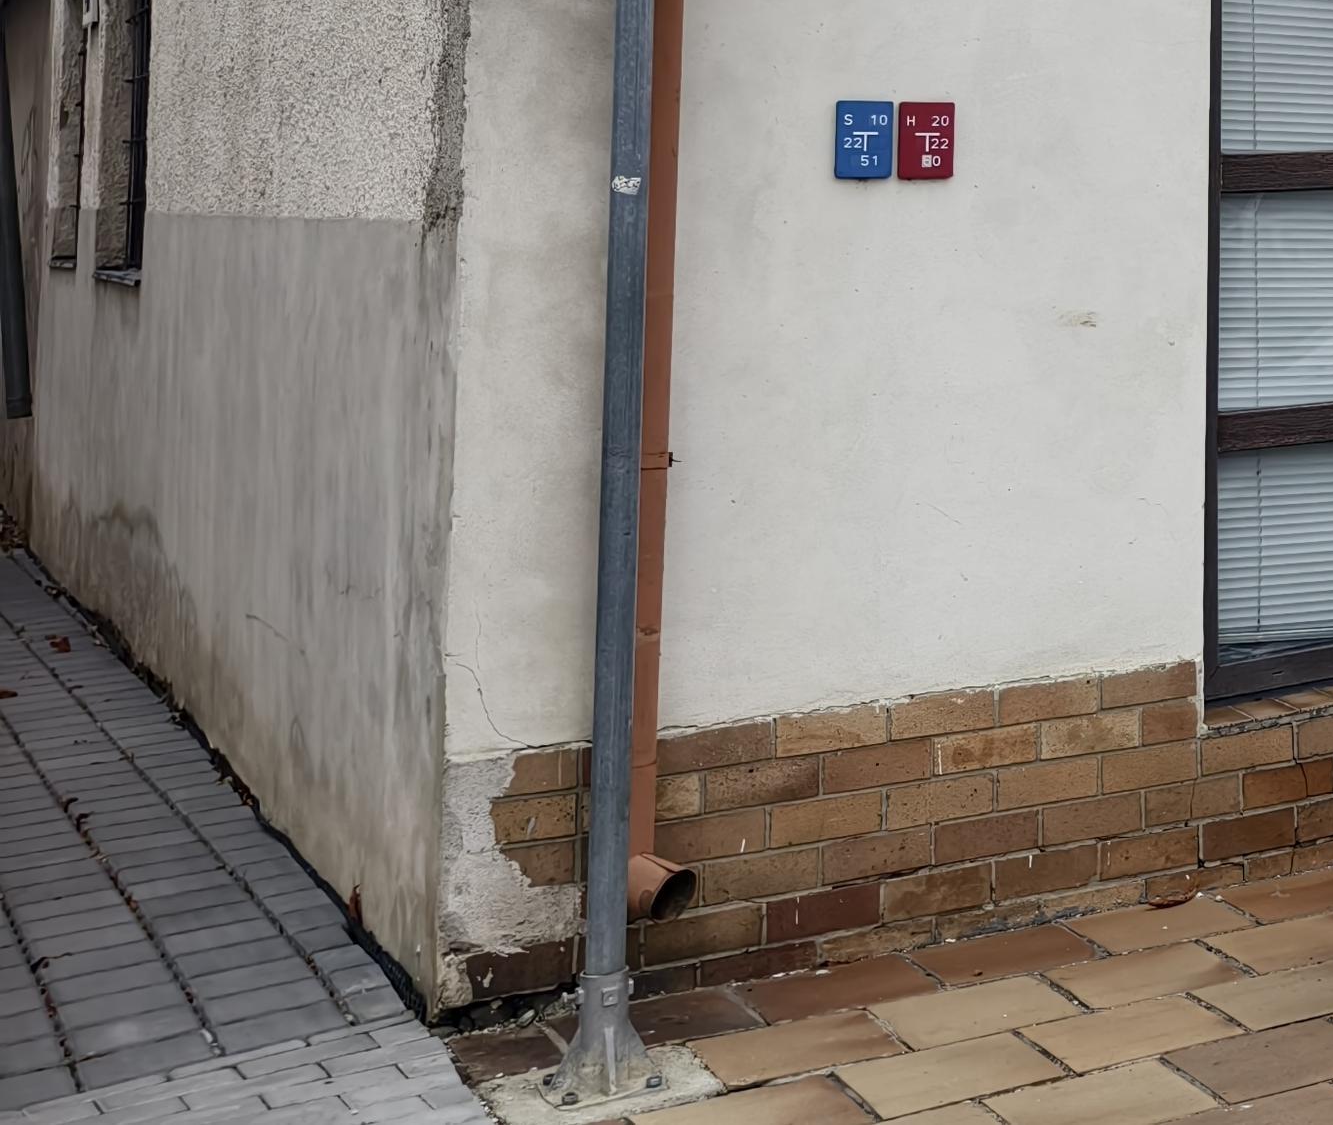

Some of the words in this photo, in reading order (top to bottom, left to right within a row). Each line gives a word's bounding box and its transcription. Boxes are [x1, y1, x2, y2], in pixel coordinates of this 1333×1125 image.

[843, 114, 853, 126] S
[870, 114, 888, 126] 10
[906, 115, 916, 127] H
[931, 115, 950, 127] 20
[843, 137, 863, 149] 22
[930, 138, 949, 150] 22
[860, 154, 878, 167] 51
